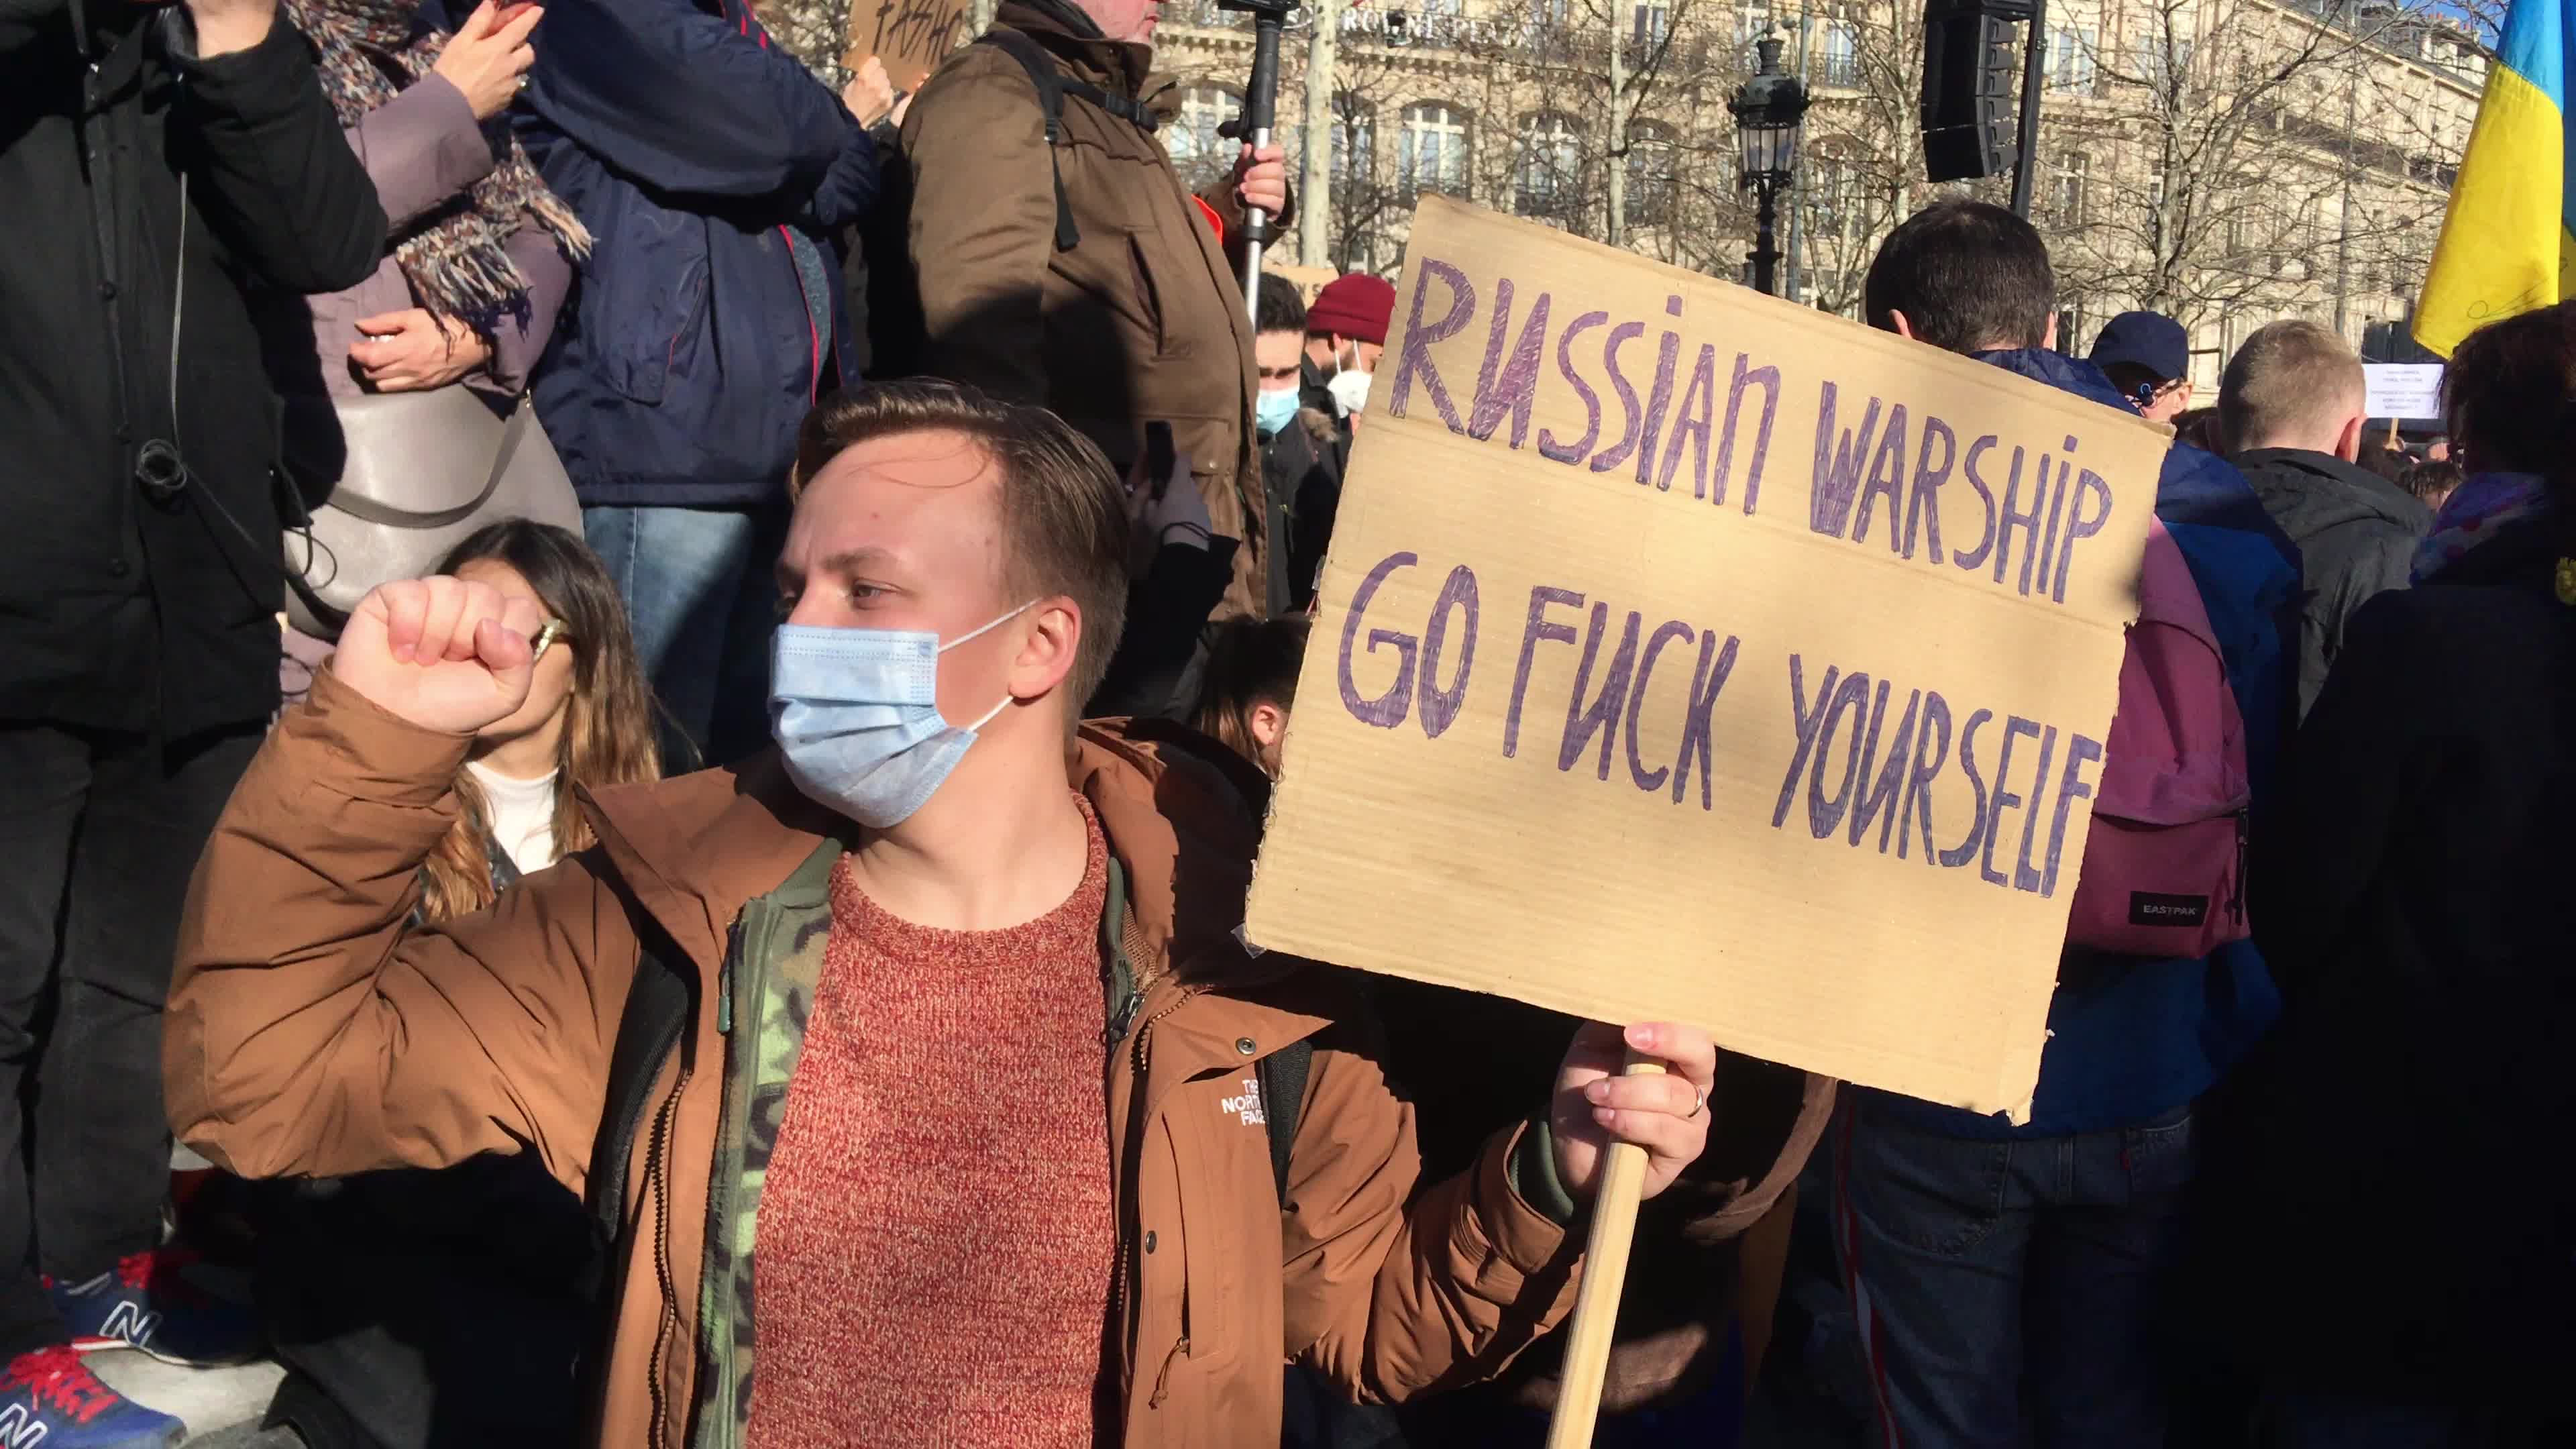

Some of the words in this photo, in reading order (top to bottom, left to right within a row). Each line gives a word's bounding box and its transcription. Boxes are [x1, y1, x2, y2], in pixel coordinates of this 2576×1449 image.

[1338, 551, 1479, 739] GO
[1503, 585, 1740, 811] FUCK
[1772, 653, 2102, 898] YOURSELF
[2143, 905, 2196, 916] EASTPAK
[1221, 1094, 1262, 1114] NORT
[99, 1301, 162, 1347] N
